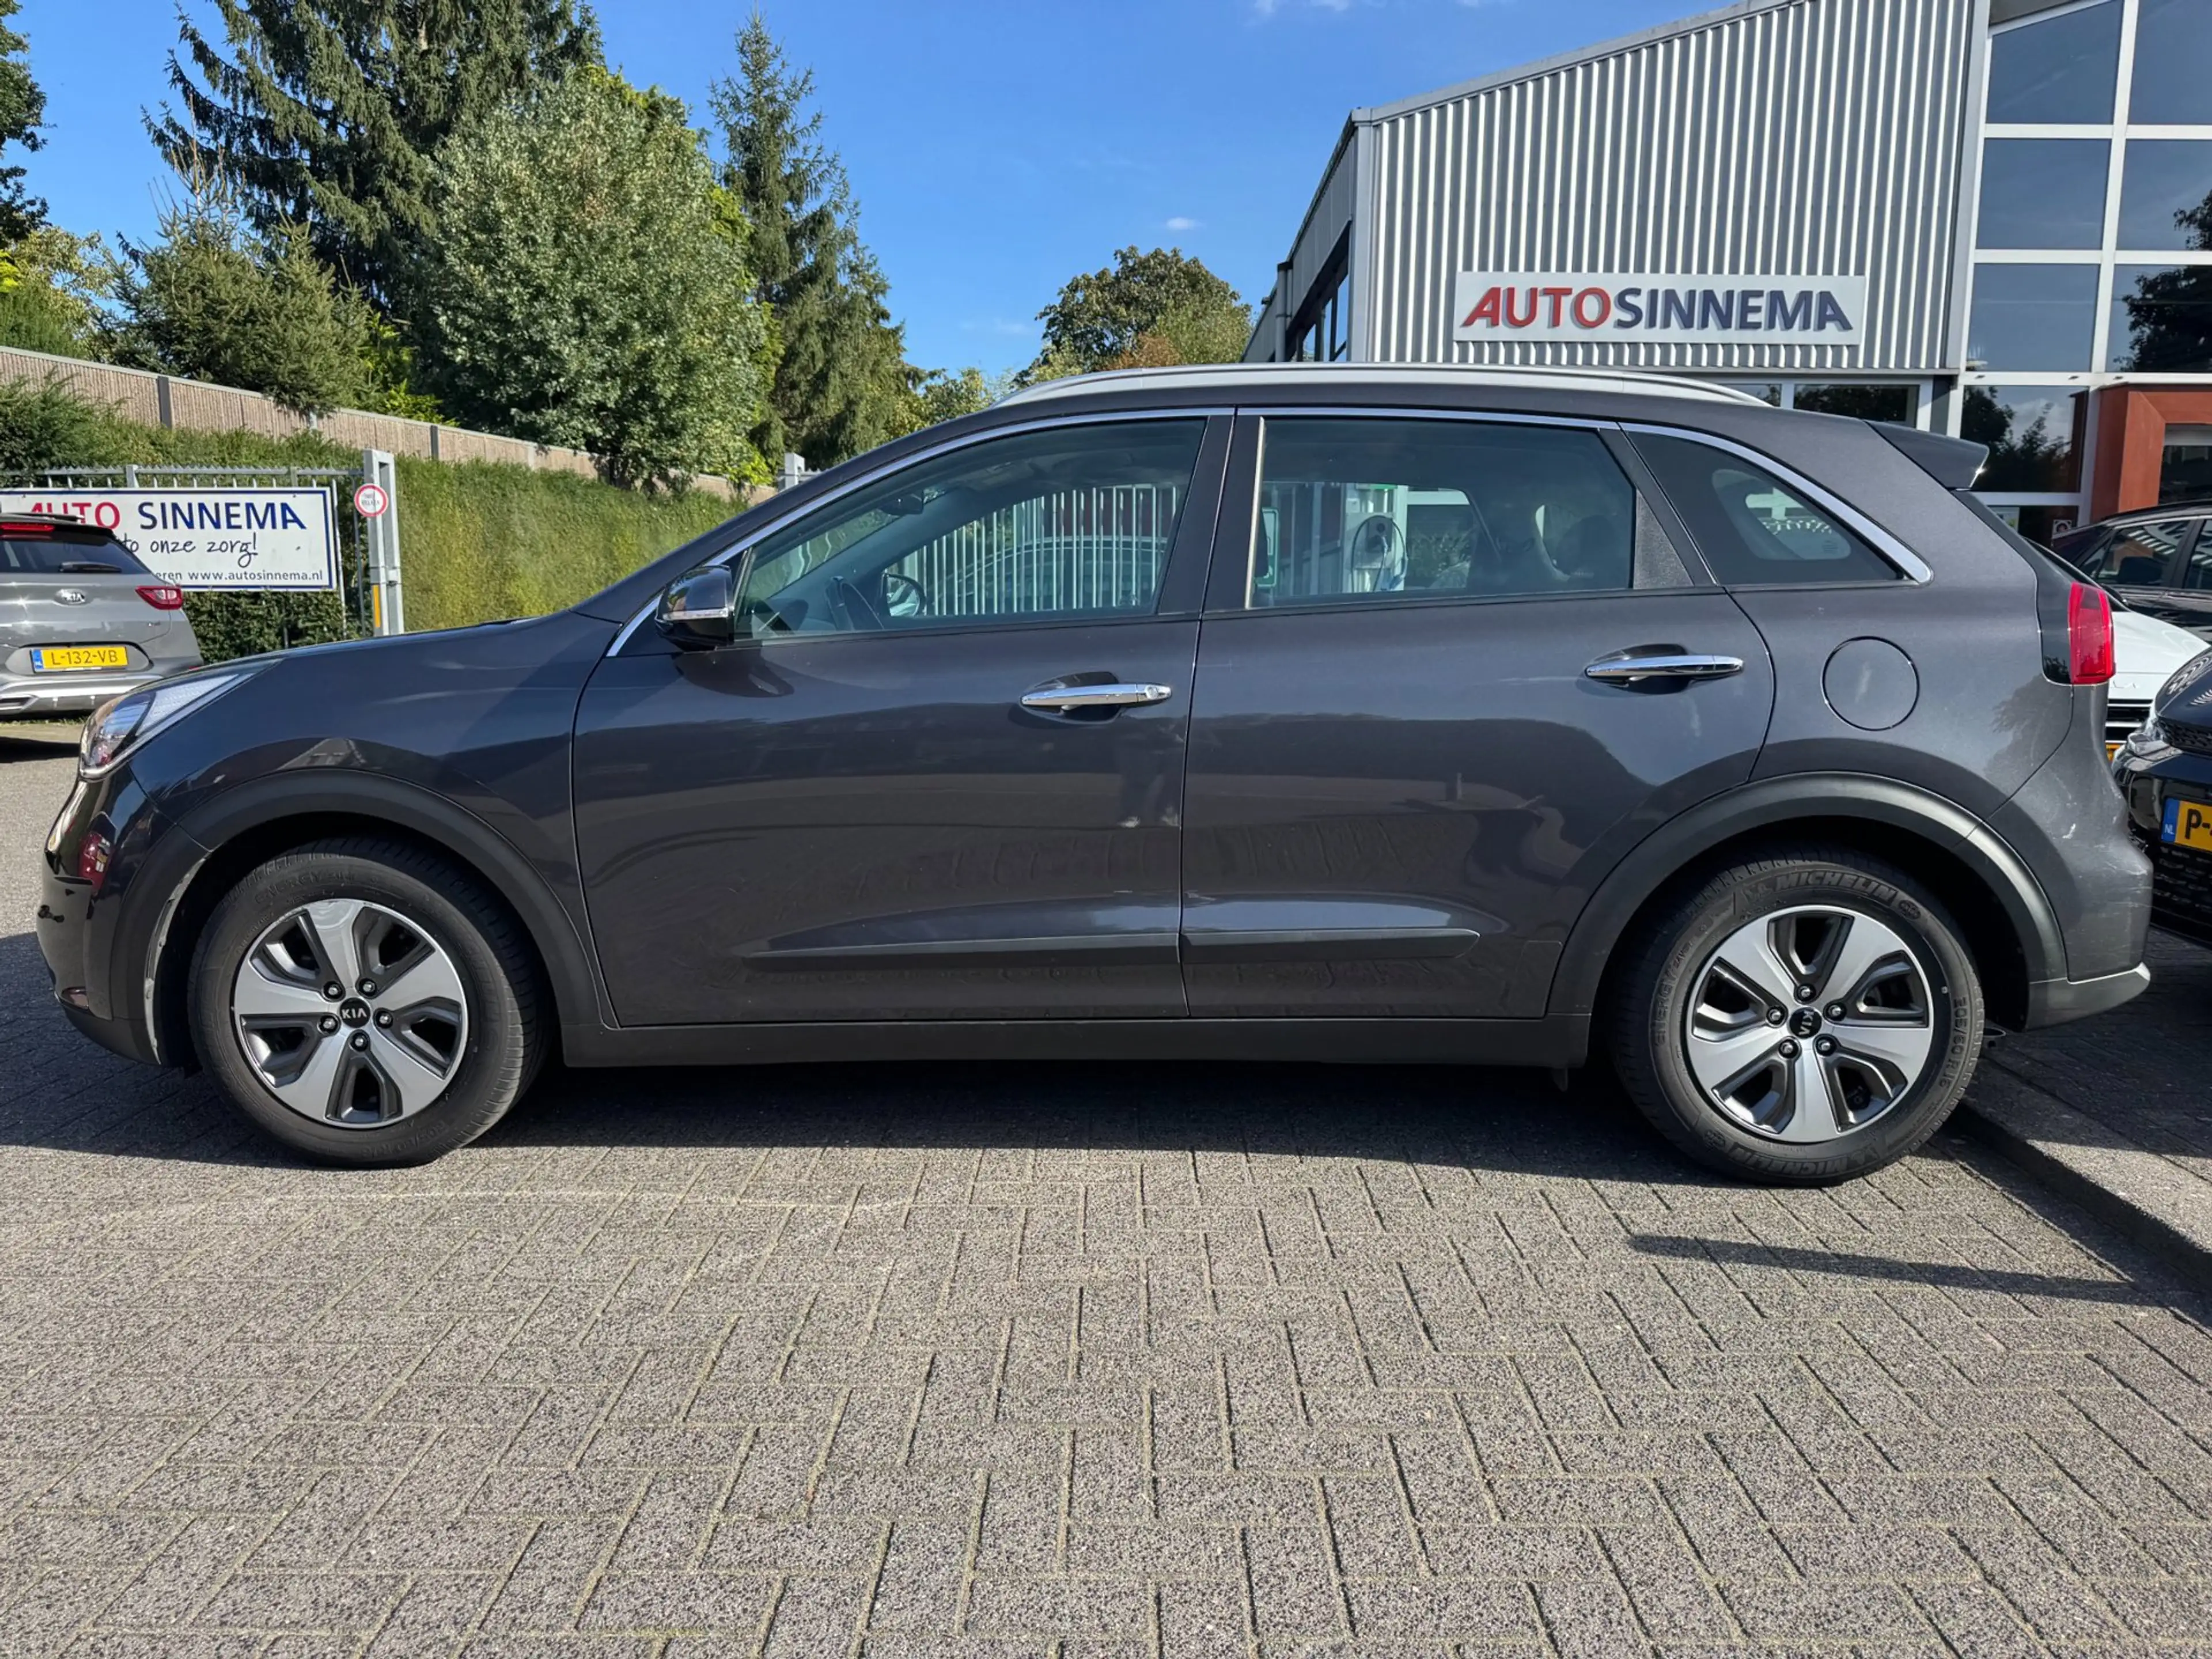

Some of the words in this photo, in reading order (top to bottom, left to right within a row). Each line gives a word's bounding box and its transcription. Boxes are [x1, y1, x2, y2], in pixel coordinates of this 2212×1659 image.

[1461, 287, 1854, 331] AUTOSINNEMA
[138, 502, 307, 529] SINNEMA
[150, 539, 196, 553] onze
[206, 532, 259, 567] zorg!
[188, 570, 323, 581] www.autosinnema.nl
[51, 649, 118, 665] L-132-VB
[2184, 808, 2212, 839] P-
[1775, 870, 1898, 906] MICHELIN
[341, 1007, 368, 1019] KIA
[1798, 1010, 1815, 1035] KIA
